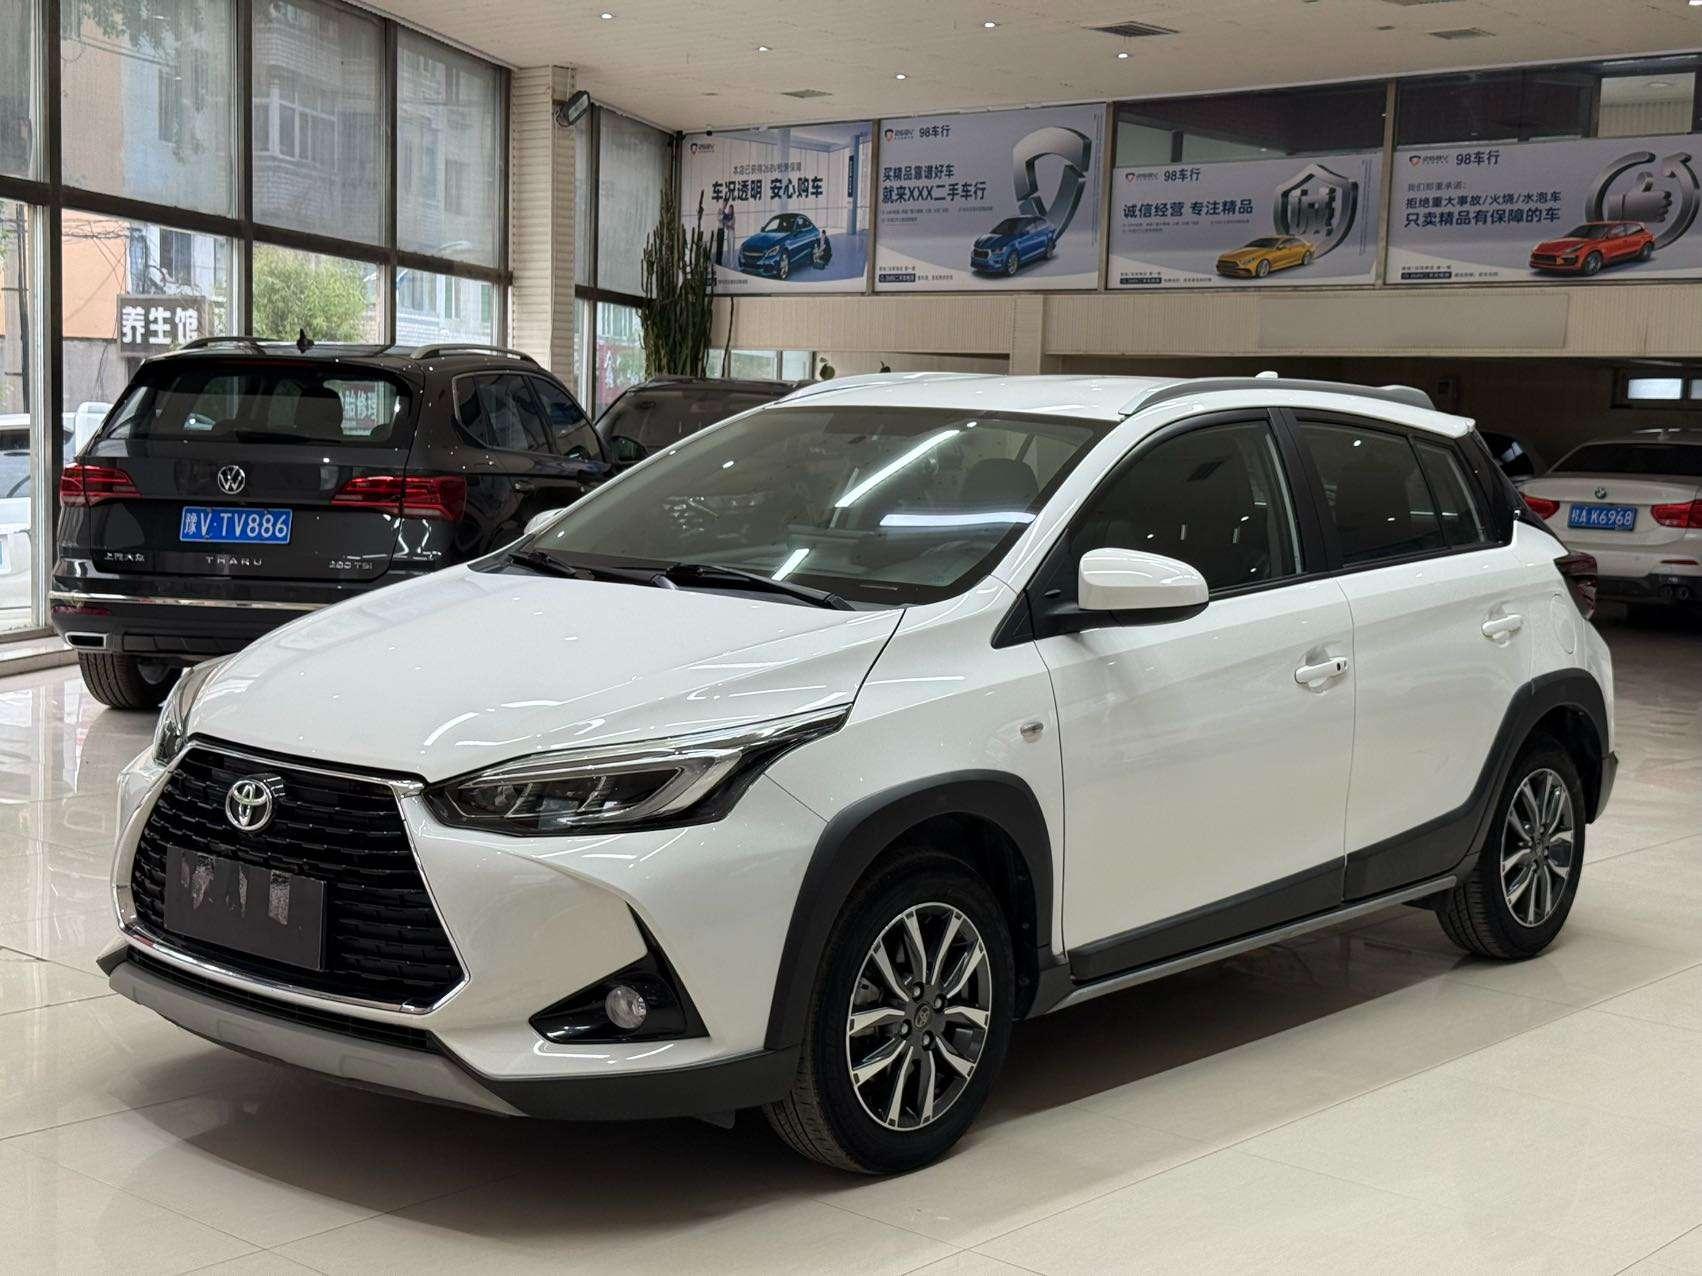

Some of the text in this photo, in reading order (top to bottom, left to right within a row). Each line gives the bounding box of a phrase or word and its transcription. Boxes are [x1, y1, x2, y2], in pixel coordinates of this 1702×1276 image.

[919, 124, 951, 139] 98车行
[1456, 149, 1500, 167] 98车行
[882, 163, 956, 183] 买精品靠谱好车
[1163, 167, 1201, 184] 98车行
[711, 177, 763, 202] 车况透明
[769, 175, 824, 200] 安心购车
[882, 180, 987, 204] 就来XXX二手车行
[1123, 198, 1254, 219] 诚信经营 专注精品
[1405, 190, 1562, 210] 拒绝重大事故/火烧/水泡车
[1403, 206, 1561, 228] 只卖精品有保障的车
[122, 305, 199, 345] 养生馆
[205, 555, 263, 566] THARU
